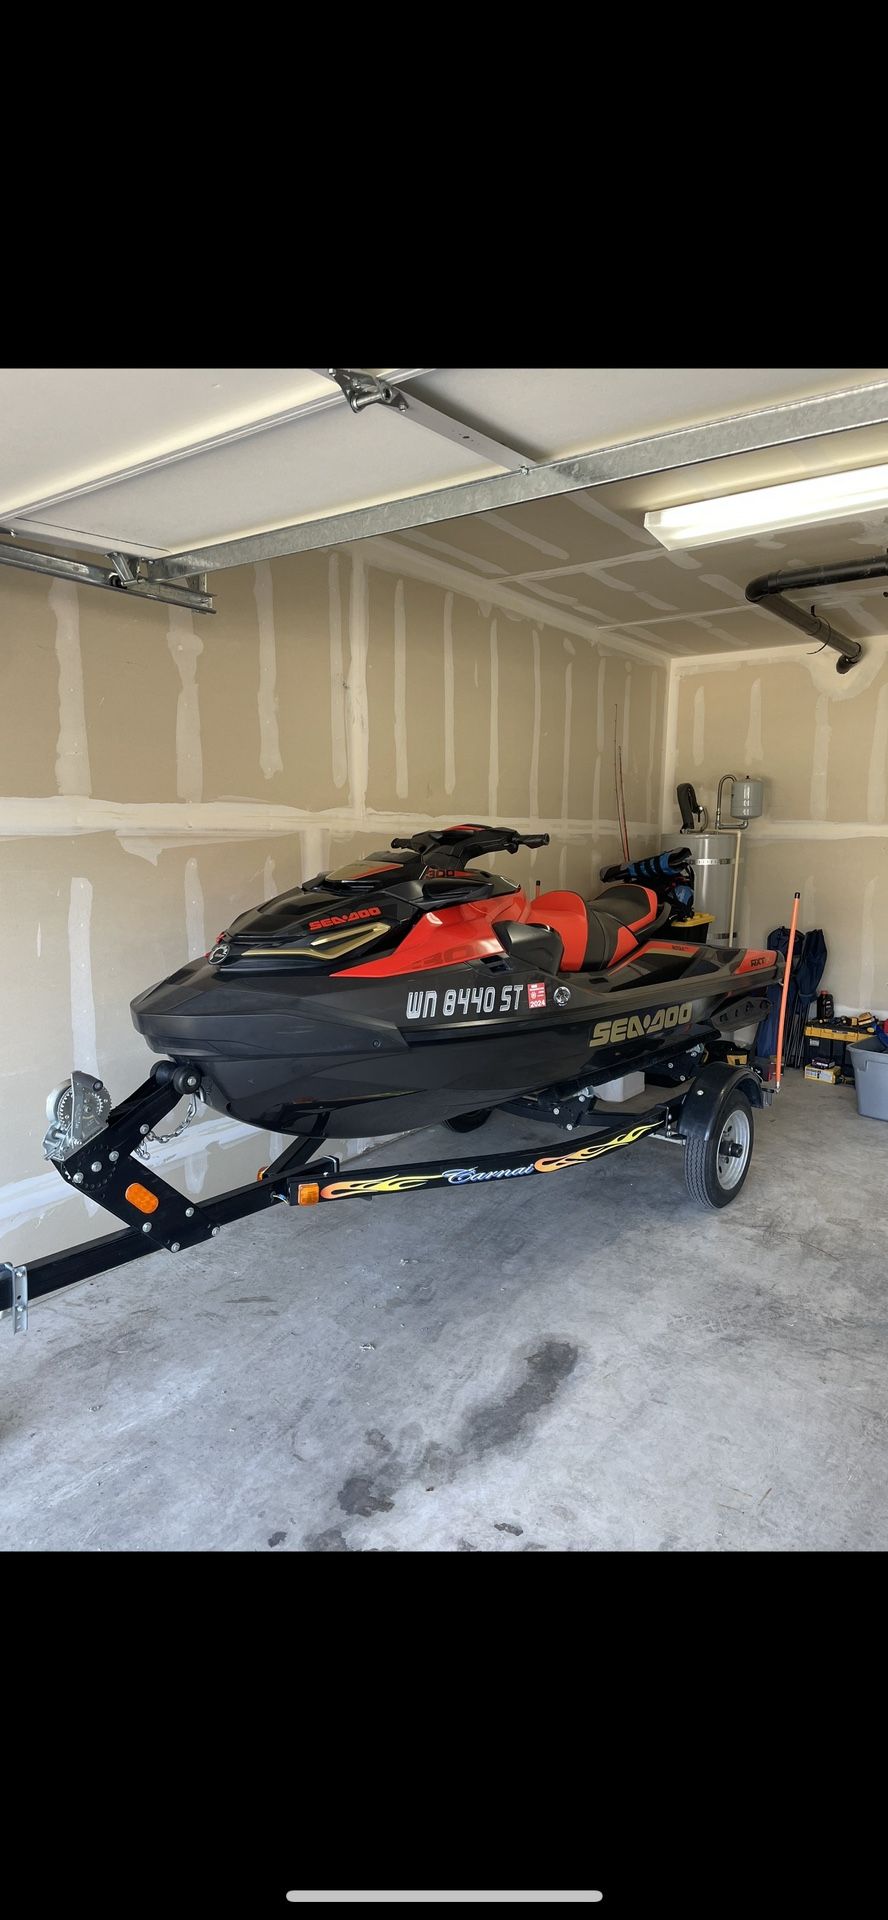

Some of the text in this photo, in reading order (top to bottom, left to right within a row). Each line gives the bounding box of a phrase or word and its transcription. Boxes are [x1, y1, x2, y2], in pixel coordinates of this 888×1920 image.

[442, 986, 495, 1016] 8440
[500, 984, 523, 1012] ST
[529, 999, 546, 1008] 2024
